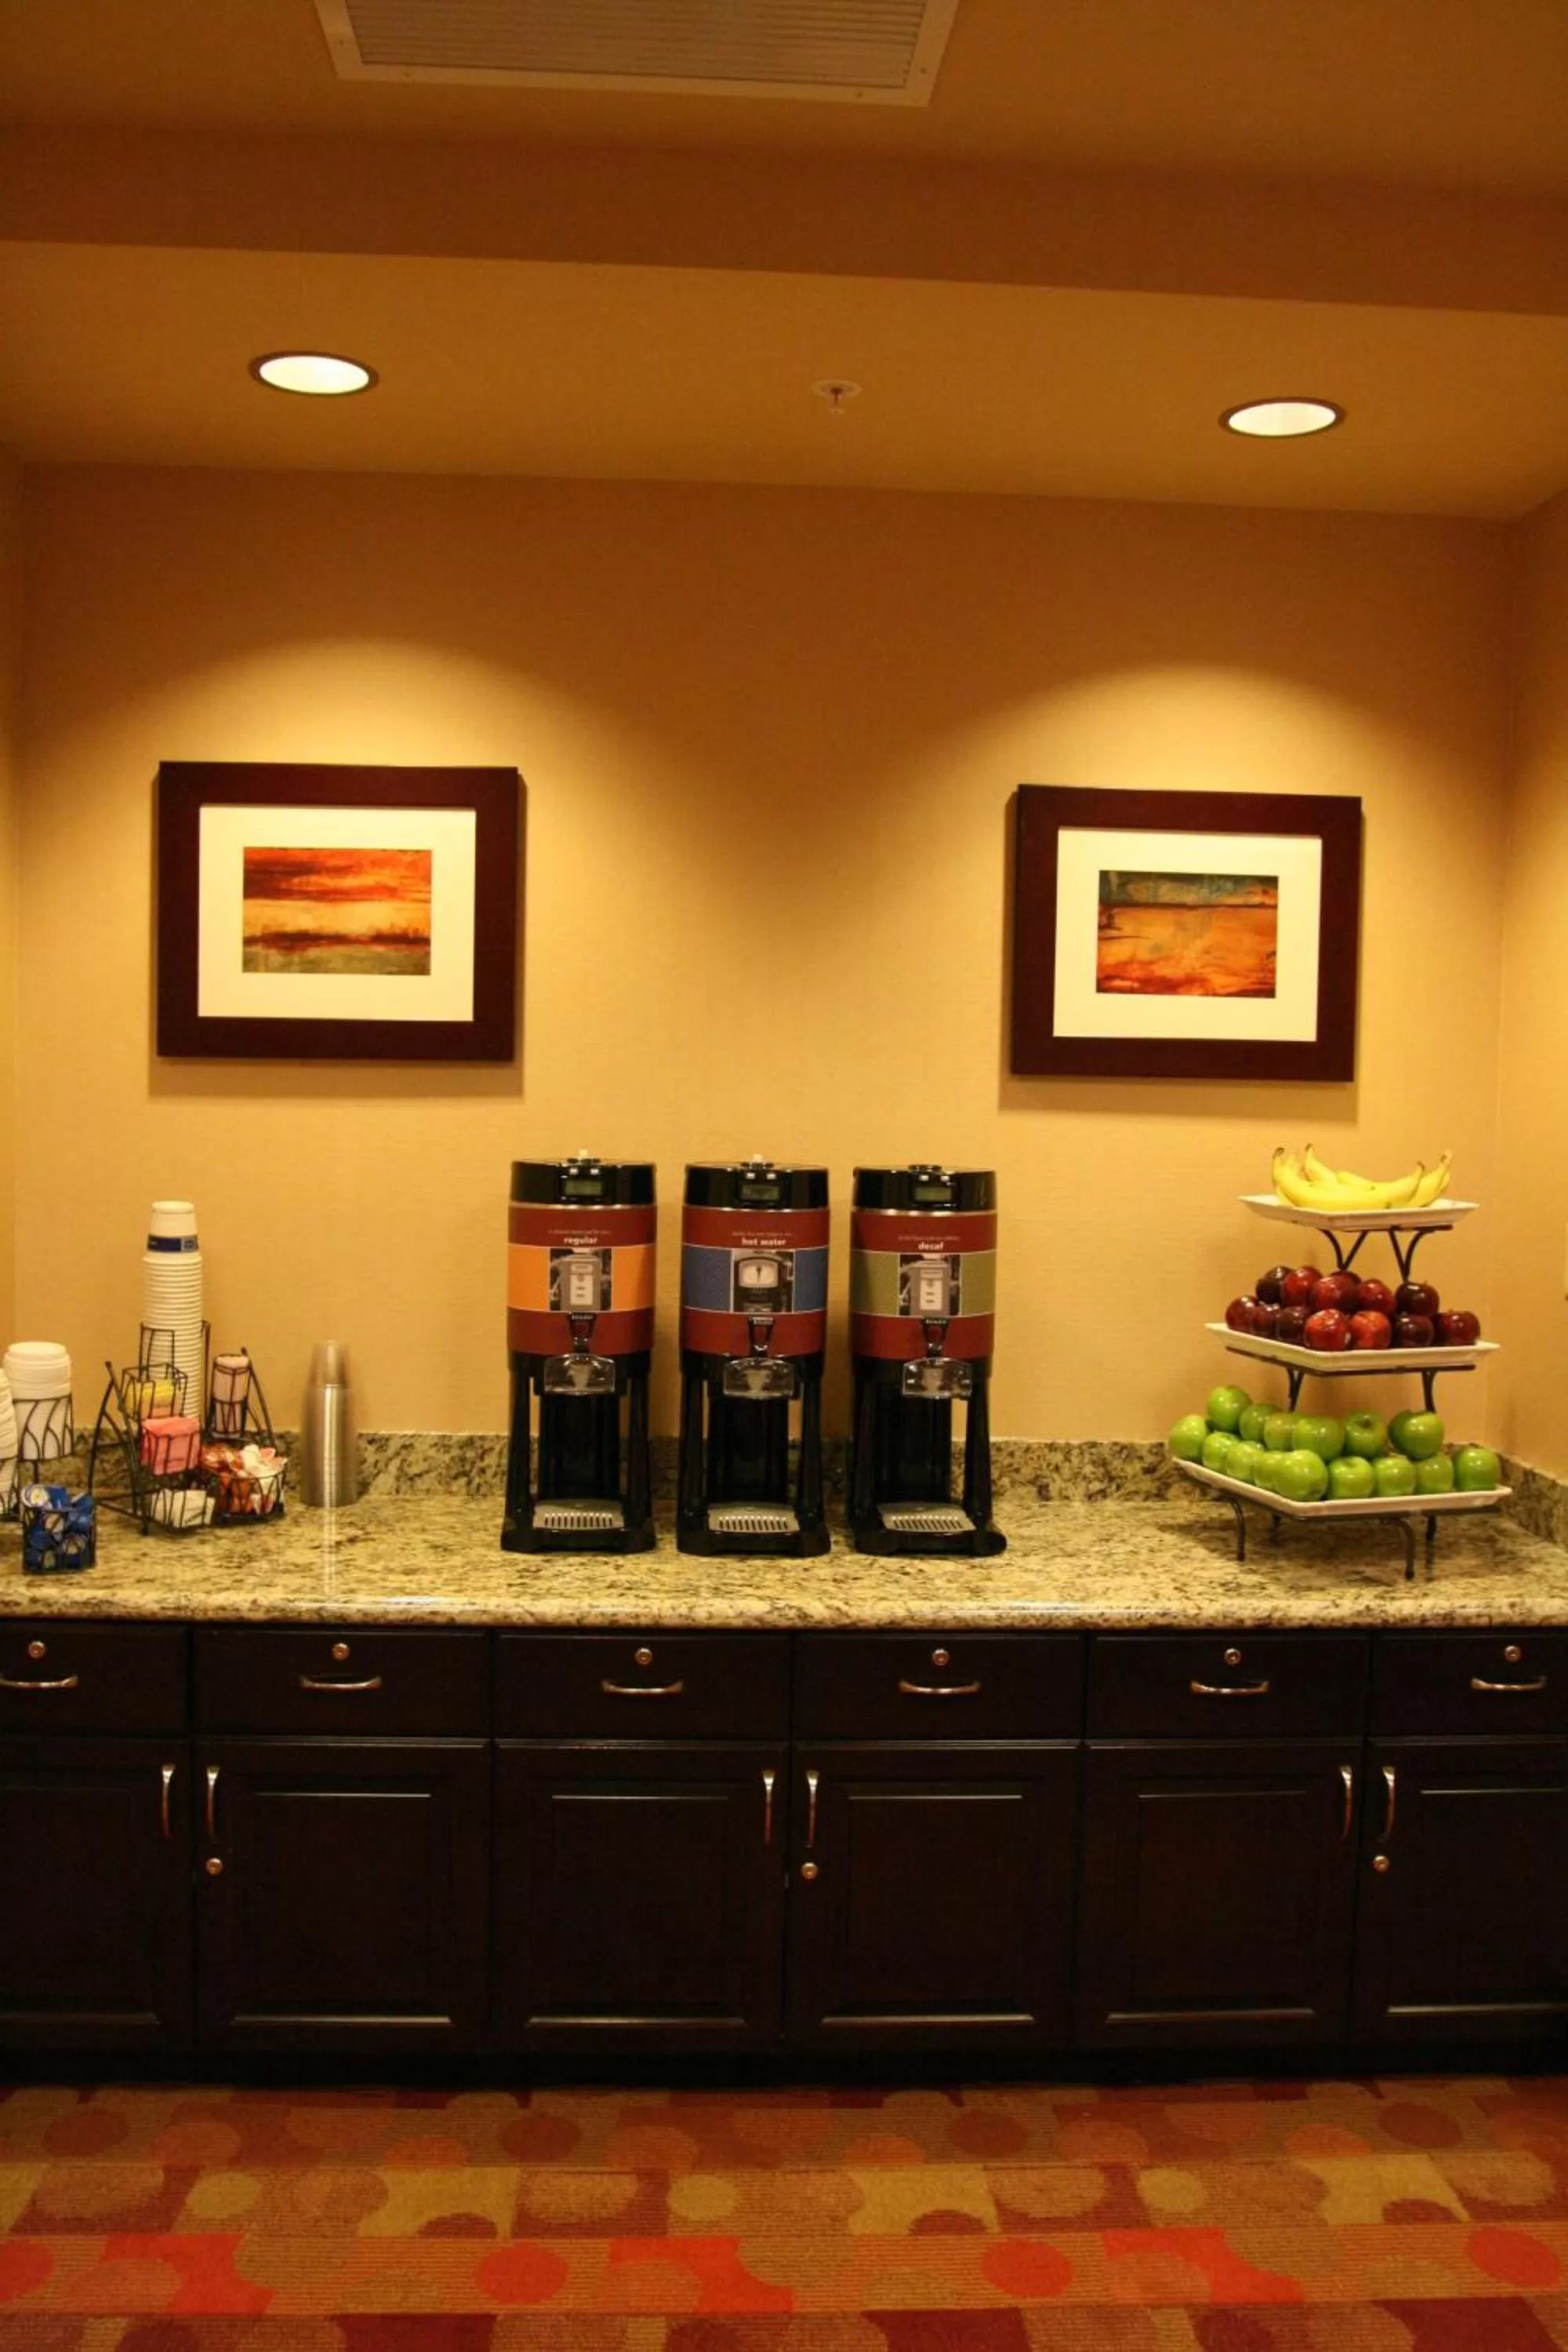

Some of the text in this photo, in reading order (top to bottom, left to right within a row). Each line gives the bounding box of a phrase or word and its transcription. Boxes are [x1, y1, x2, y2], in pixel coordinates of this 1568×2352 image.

[564, 1236, 598, 1246] regular
[741, 1236, 758, 1246] hot
[917, 1241, 944, 1250] decaf
